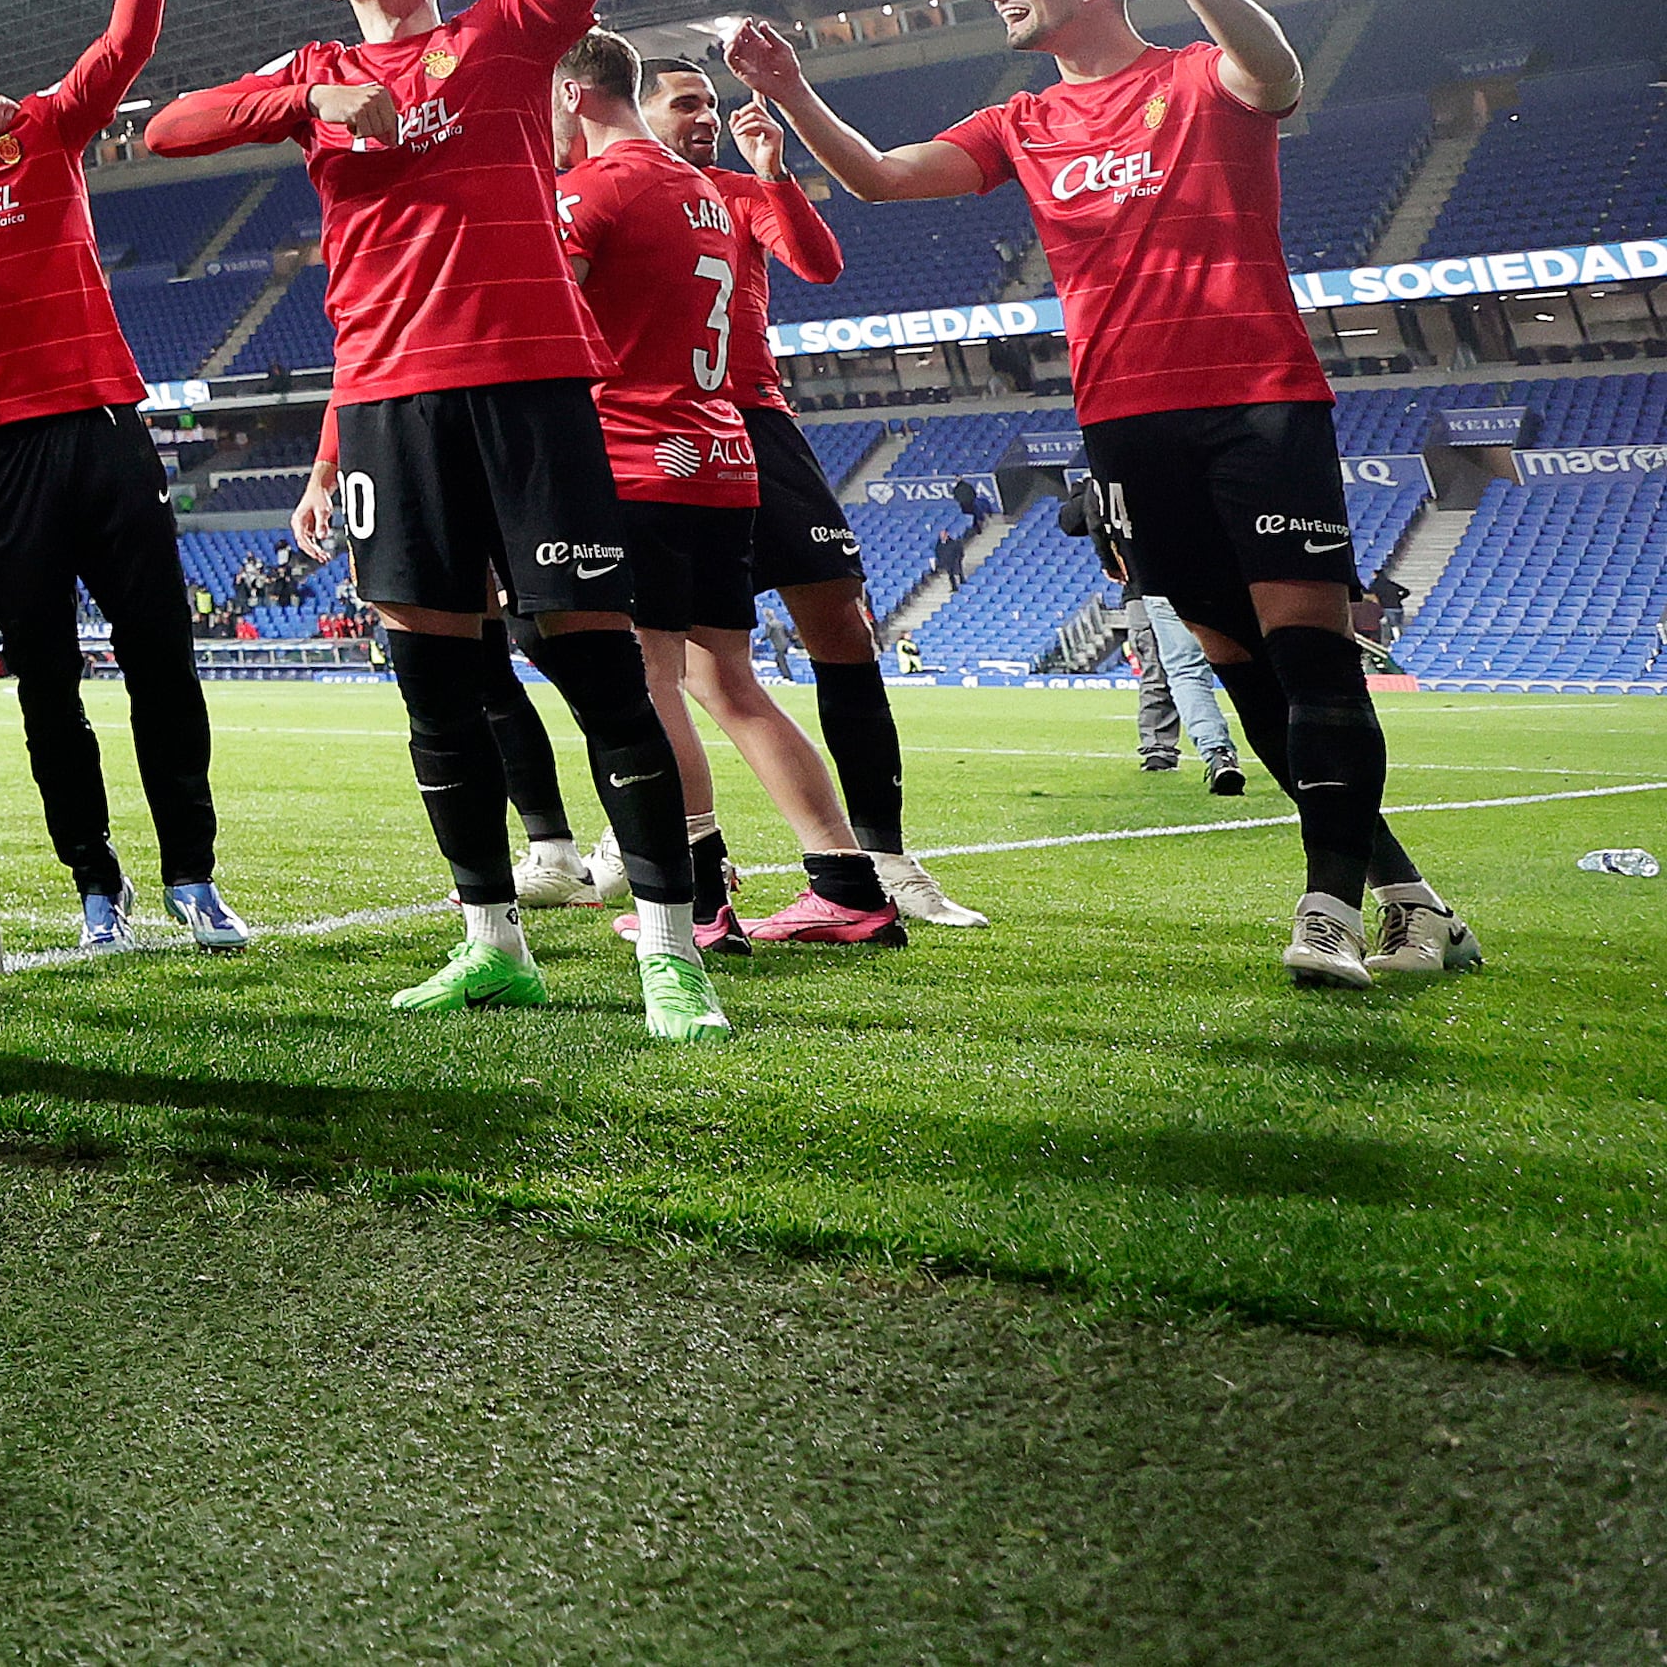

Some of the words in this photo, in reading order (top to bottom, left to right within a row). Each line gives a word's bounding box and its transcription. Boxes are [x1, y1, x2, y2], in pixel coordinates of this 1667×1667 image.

[1113, 190, 1128, 205] by
[1349, 239, 1667, 304] SOCIEDAD
[692, 254, 734, 392] 3
[799, 302, 1037, 352] SOCIEDAD
